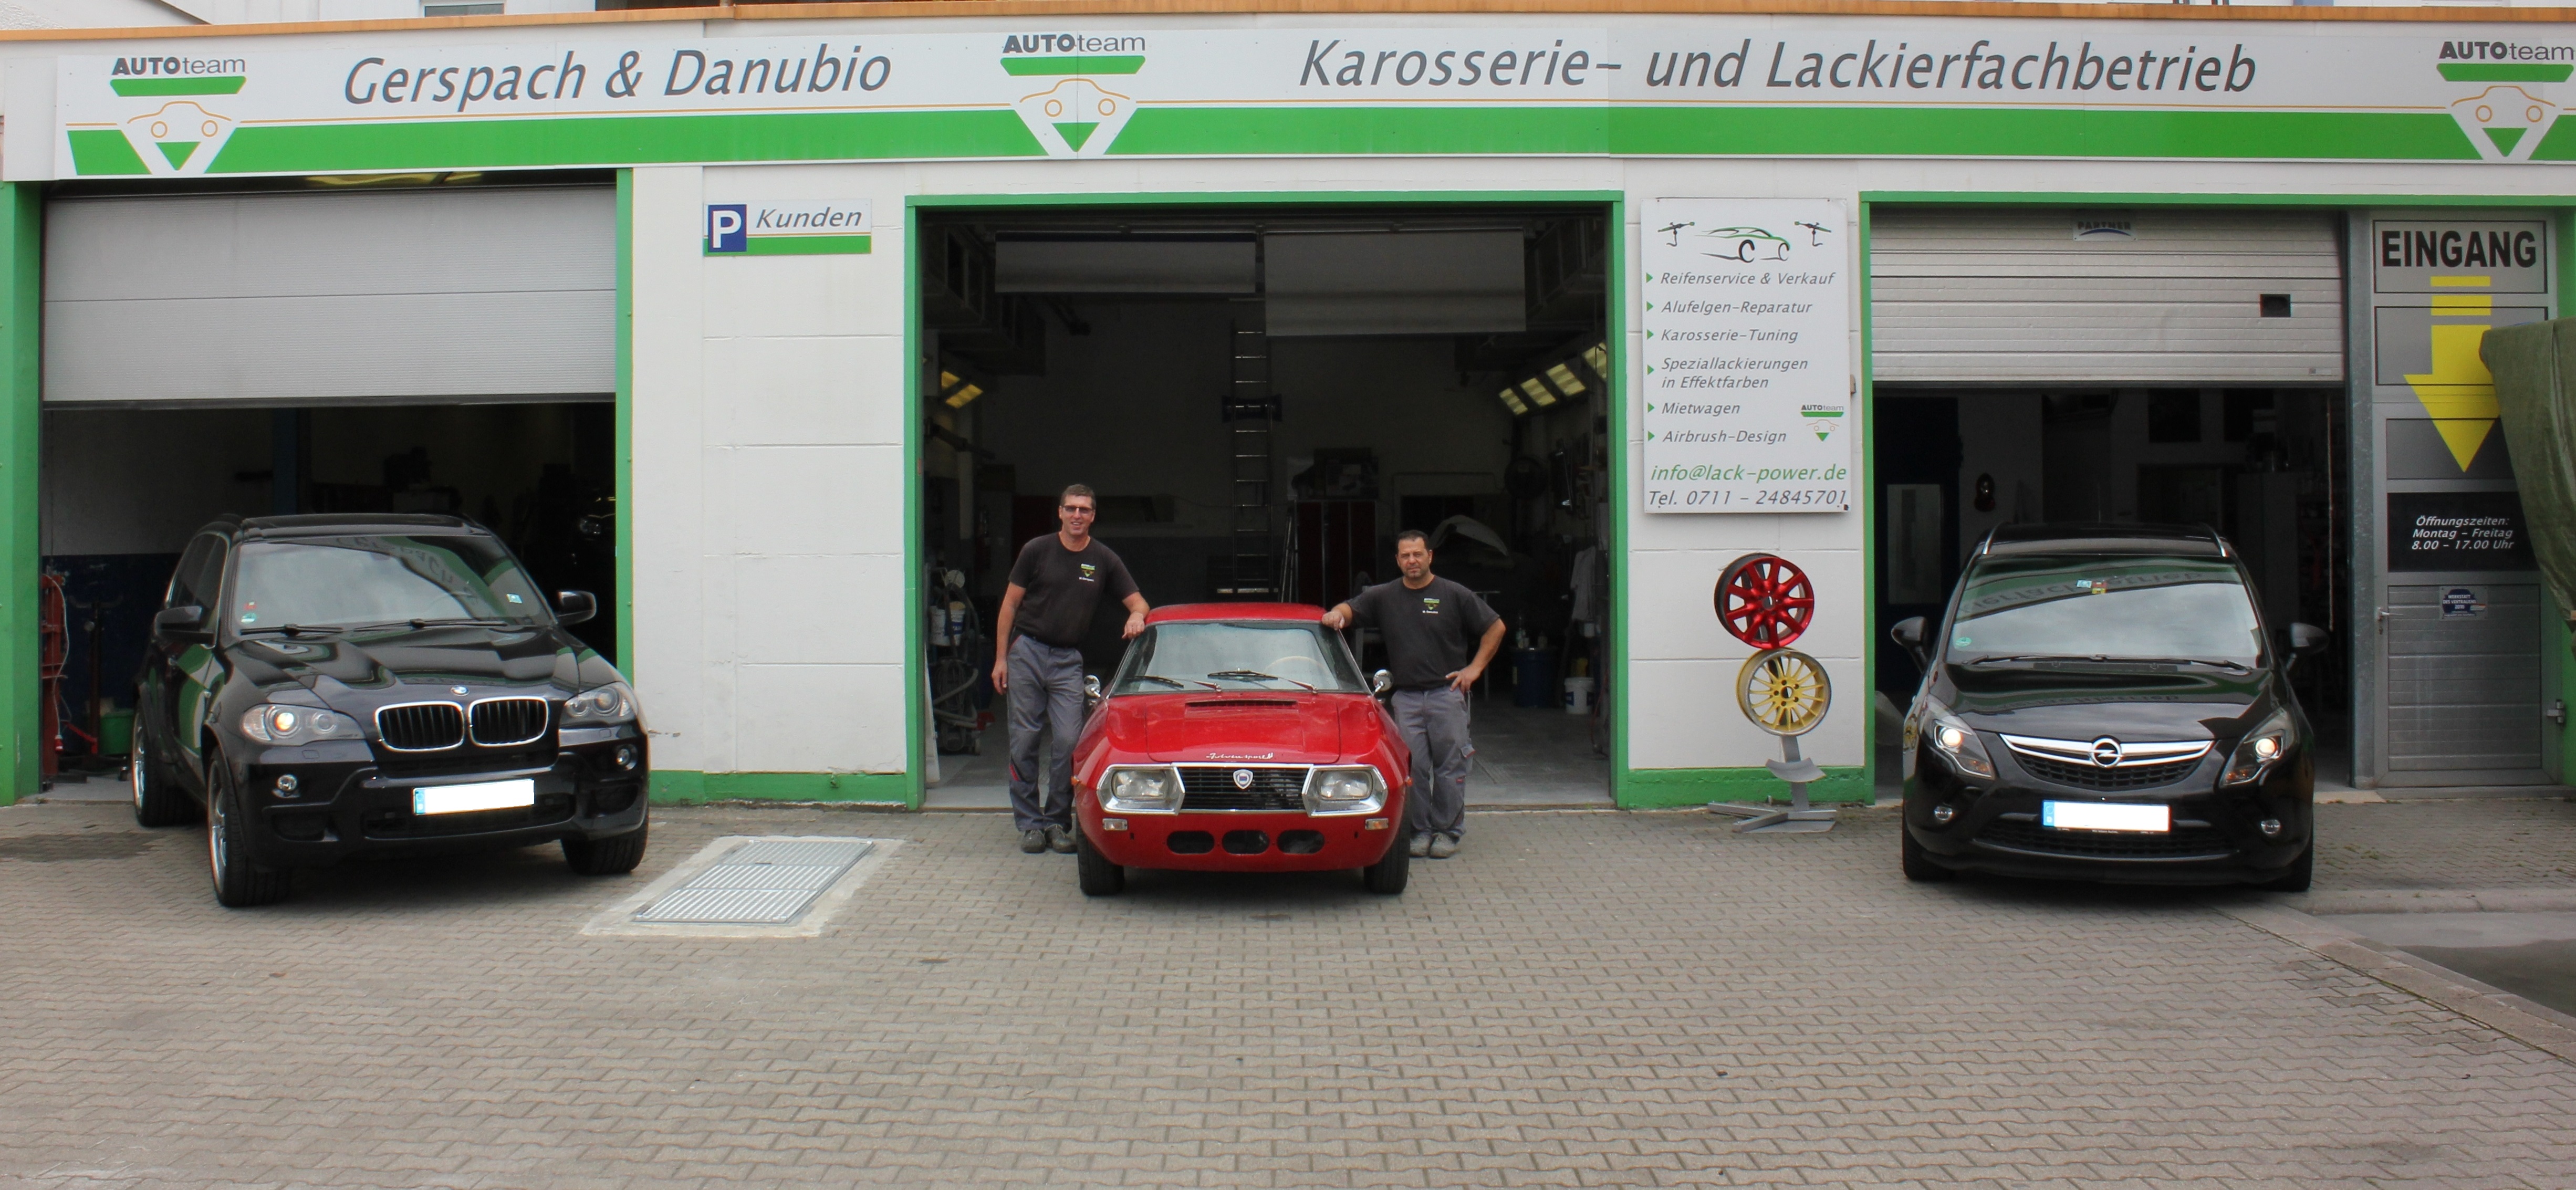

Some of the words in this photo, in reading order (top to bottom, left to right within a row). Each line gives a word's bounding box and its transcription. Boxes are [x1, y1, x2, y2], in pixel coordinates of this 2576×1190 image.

[1002, 34, 1146, 54] AUTOteam
[2439, 41, 2574, 60] AUTOteam
[112, 56, 246, 76] AUTOteam
[1299, 39, 1622, 87] Karosserie-
[1646, 38, 1752, 88] und
[1766, 39, 2256, 92] Lackierfachbetrieb
[345, 50, 587, 113] Gerspach
[604, 50, 643, 98] &
[663, 43, 891, 97] Danubio
[713, 211, 742, 248] P
[756, 206, 862, 228] Kunden
[2382, 231, 2537, 268] EINGANG
[1661, 272, 1756, 285] Reifenservice
[1760, 272, 1771, 285] &
[1778, 272, 1836, 285] Verkauf
[1661, 300, 1813, 316] Alufelgen-Reparatur
[1661, 329, 1798, 344] Karosserie-Tuning
[1661, 357, 1808, 372] Speziallackierungen
[1662, 377, 1675, 389] in
[1680, 375, 1769, 389] Effektfarben
[1662, 402, 1740, 417] Mietwagen
[1662, 430, 1787, 445] Airbrush-Design
[1651, 464, 1847, 484] info@lack-power.de
[1649, 490, 1677, 505] Tel.
[1686, 490, 1731, 505] 0711
[1756, 489, 1847, 506] 24845701
[2416, 515, 2510, 528] Öffnungszeiten:
[2412, 528, 2457, 540] Montag
[2471, 528, 2514, 539] Freitag
[2411, 540, 2439, 550] 8.00
[2455, 540, 2489, 550] 17.00
[2493, 539, 2515, 549] Uhr
